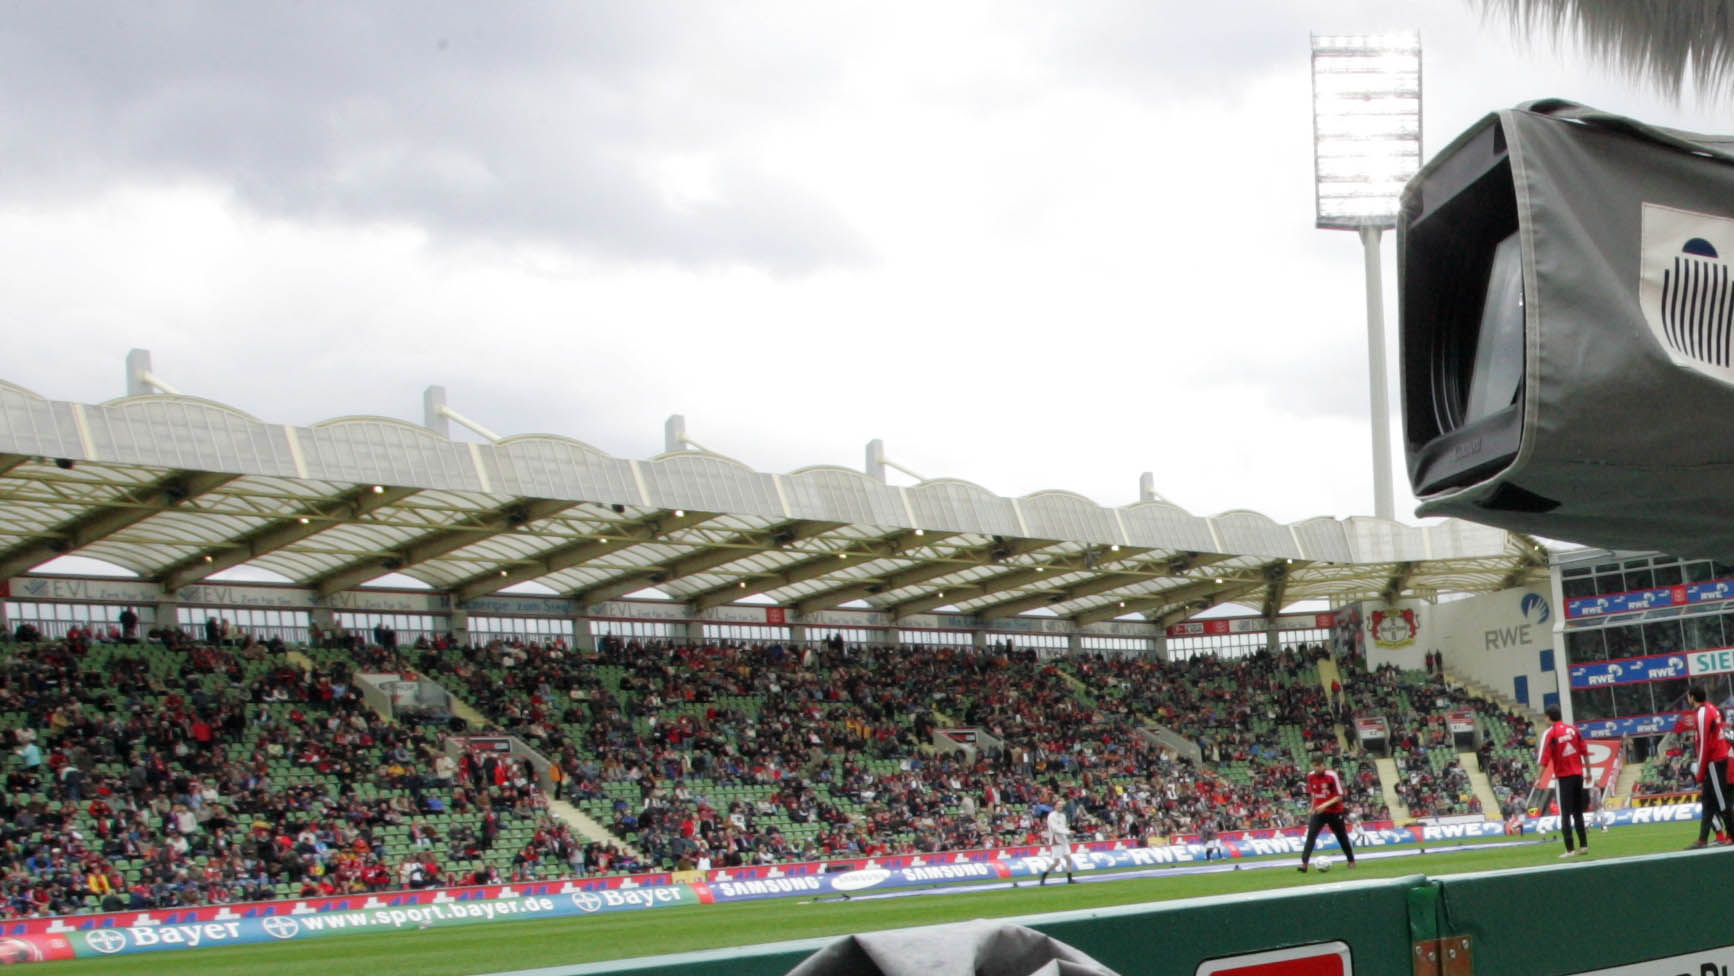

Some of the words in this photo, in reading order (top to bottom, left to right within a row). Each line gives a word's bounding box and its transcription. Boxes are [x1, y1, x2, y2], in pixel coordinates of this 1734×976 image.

[1485, 624, 1533, 650] RWE
[1588, 674, 1616, 685] RWE
[1648, 667, 1676, 679] RWE
[1632, 802, 1693, 824] RWE
[1423, 822, 1483, 840] RWE
[1128, 844, 1194, 866] RWE
[1250, 837, 1305, 855] RWE
[901, 862, 989, 882] SAMSUNG
[601, 884, 681, 908] Bayer
[720, 875, 821, 897] SAMSUNG
[301, 895, 554, 930] www.sport.bayer.de
[126, 921, 240, 947] Bayer
